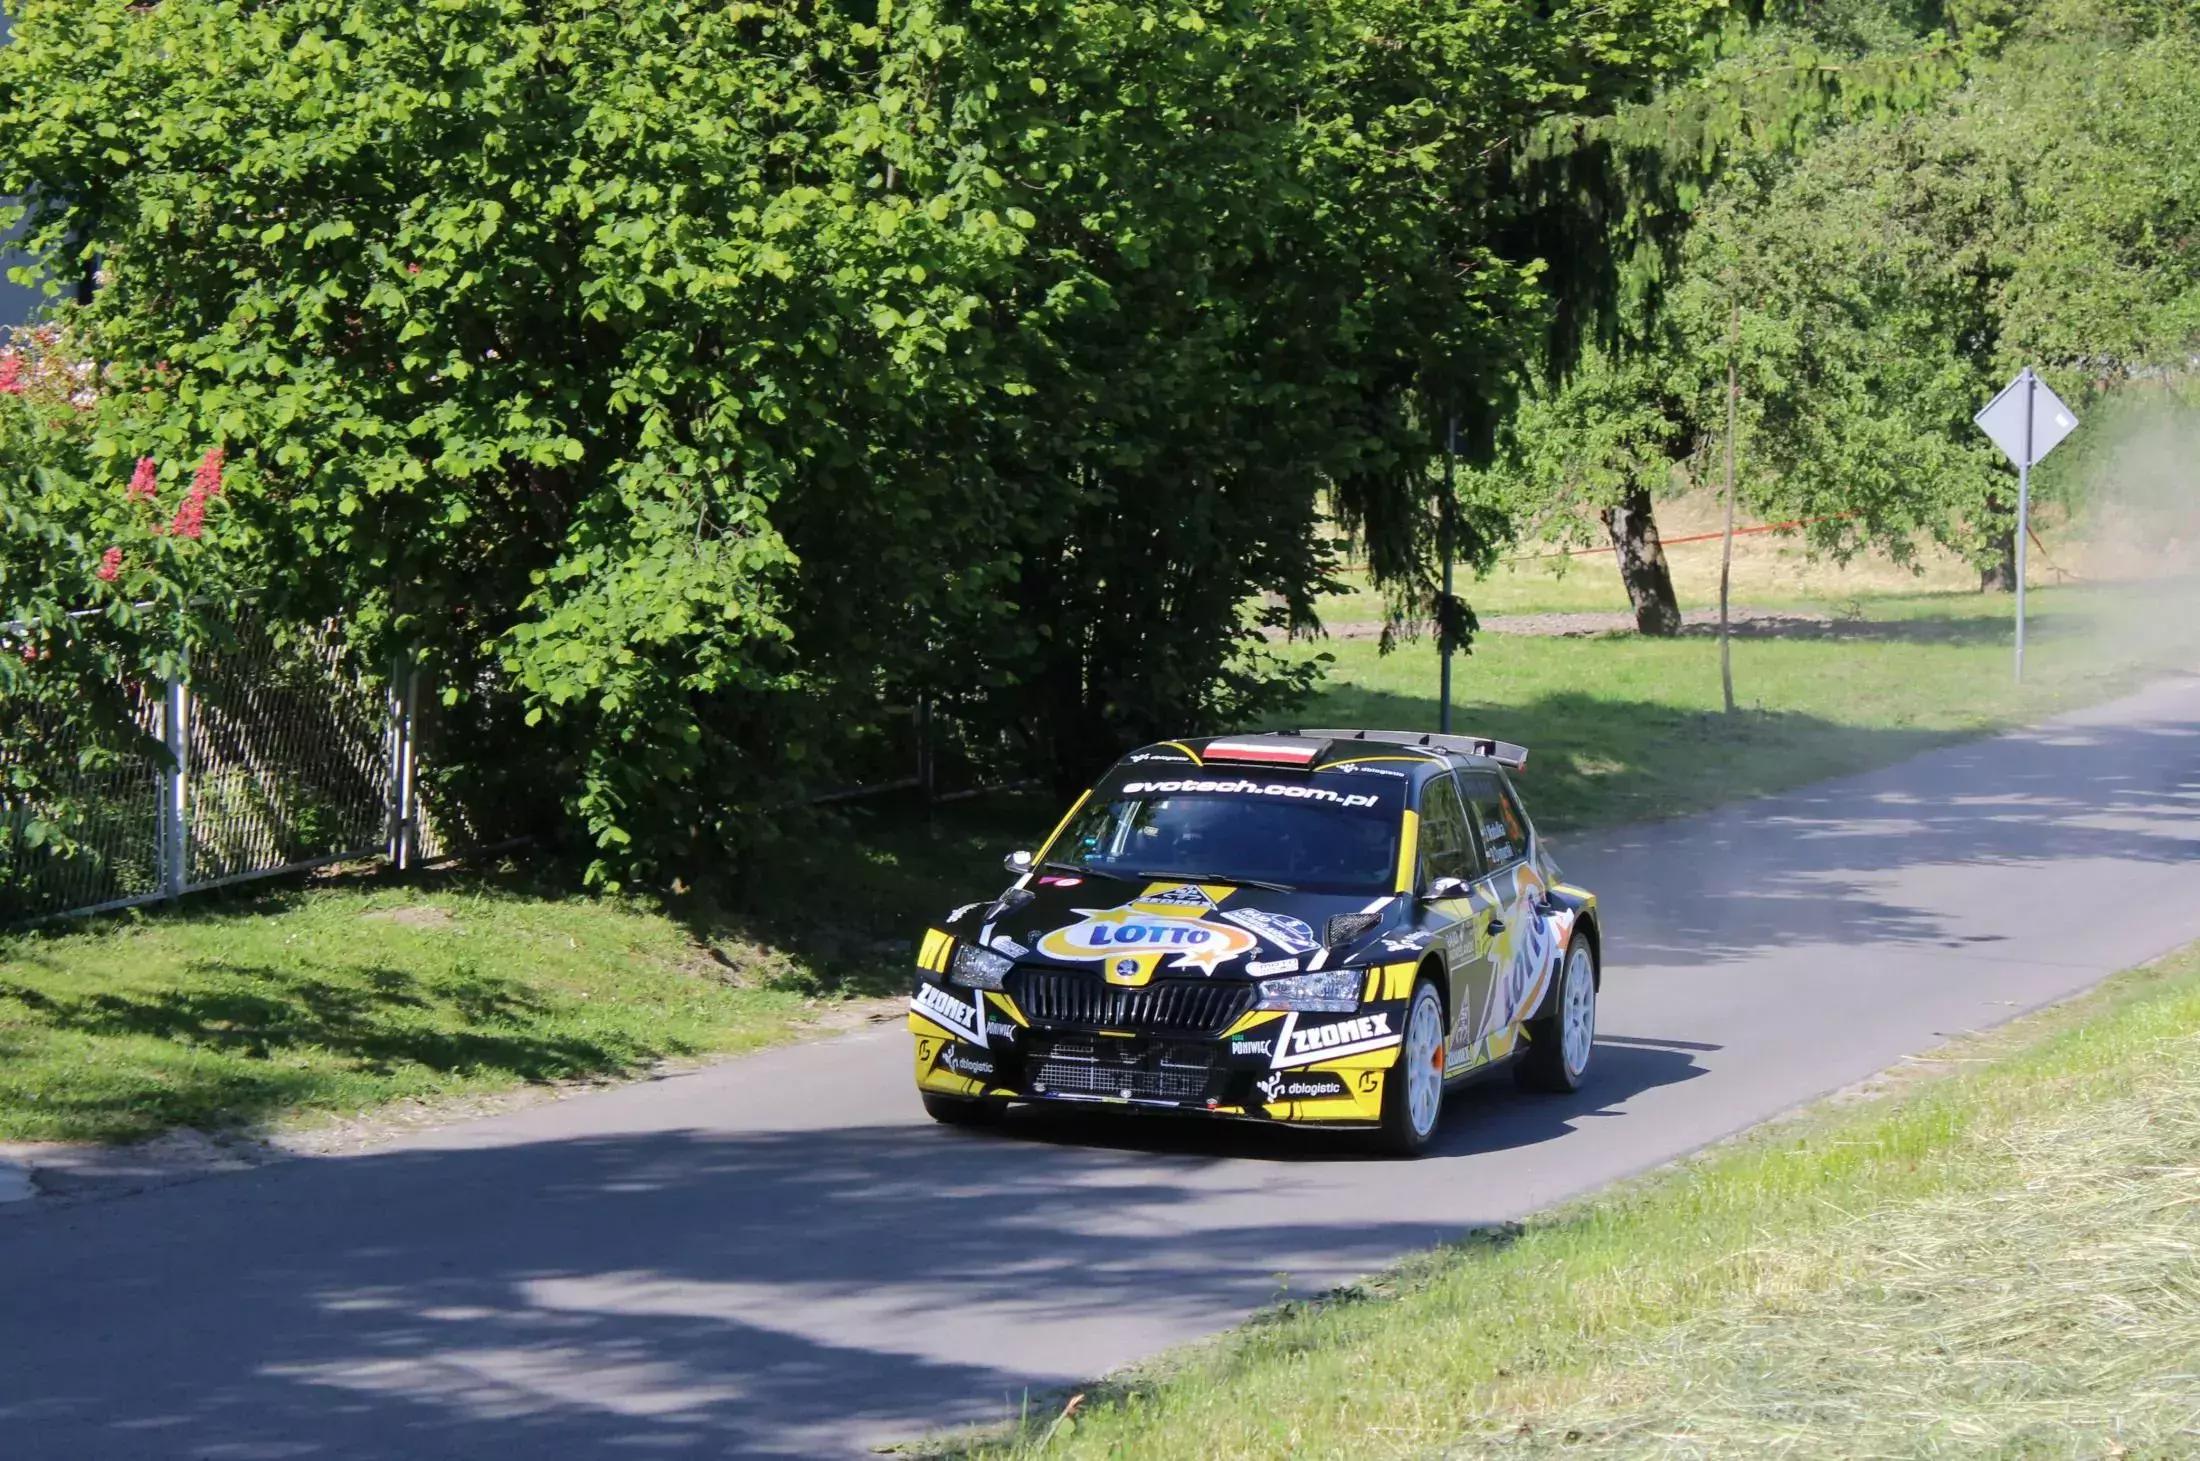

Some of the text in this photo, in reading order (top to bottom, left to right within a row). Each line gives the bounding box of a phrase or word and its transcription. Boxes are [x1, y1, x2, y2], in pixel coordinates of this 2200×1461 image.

[1122, 779, 1379, 808] evotech.com.pl
[1089, 924, 1211, 946] LOTTO
[1291, 1012, 1393, 1054] ZŁOMEX
[1288, 1081, 1341, 1097] dblogistic
